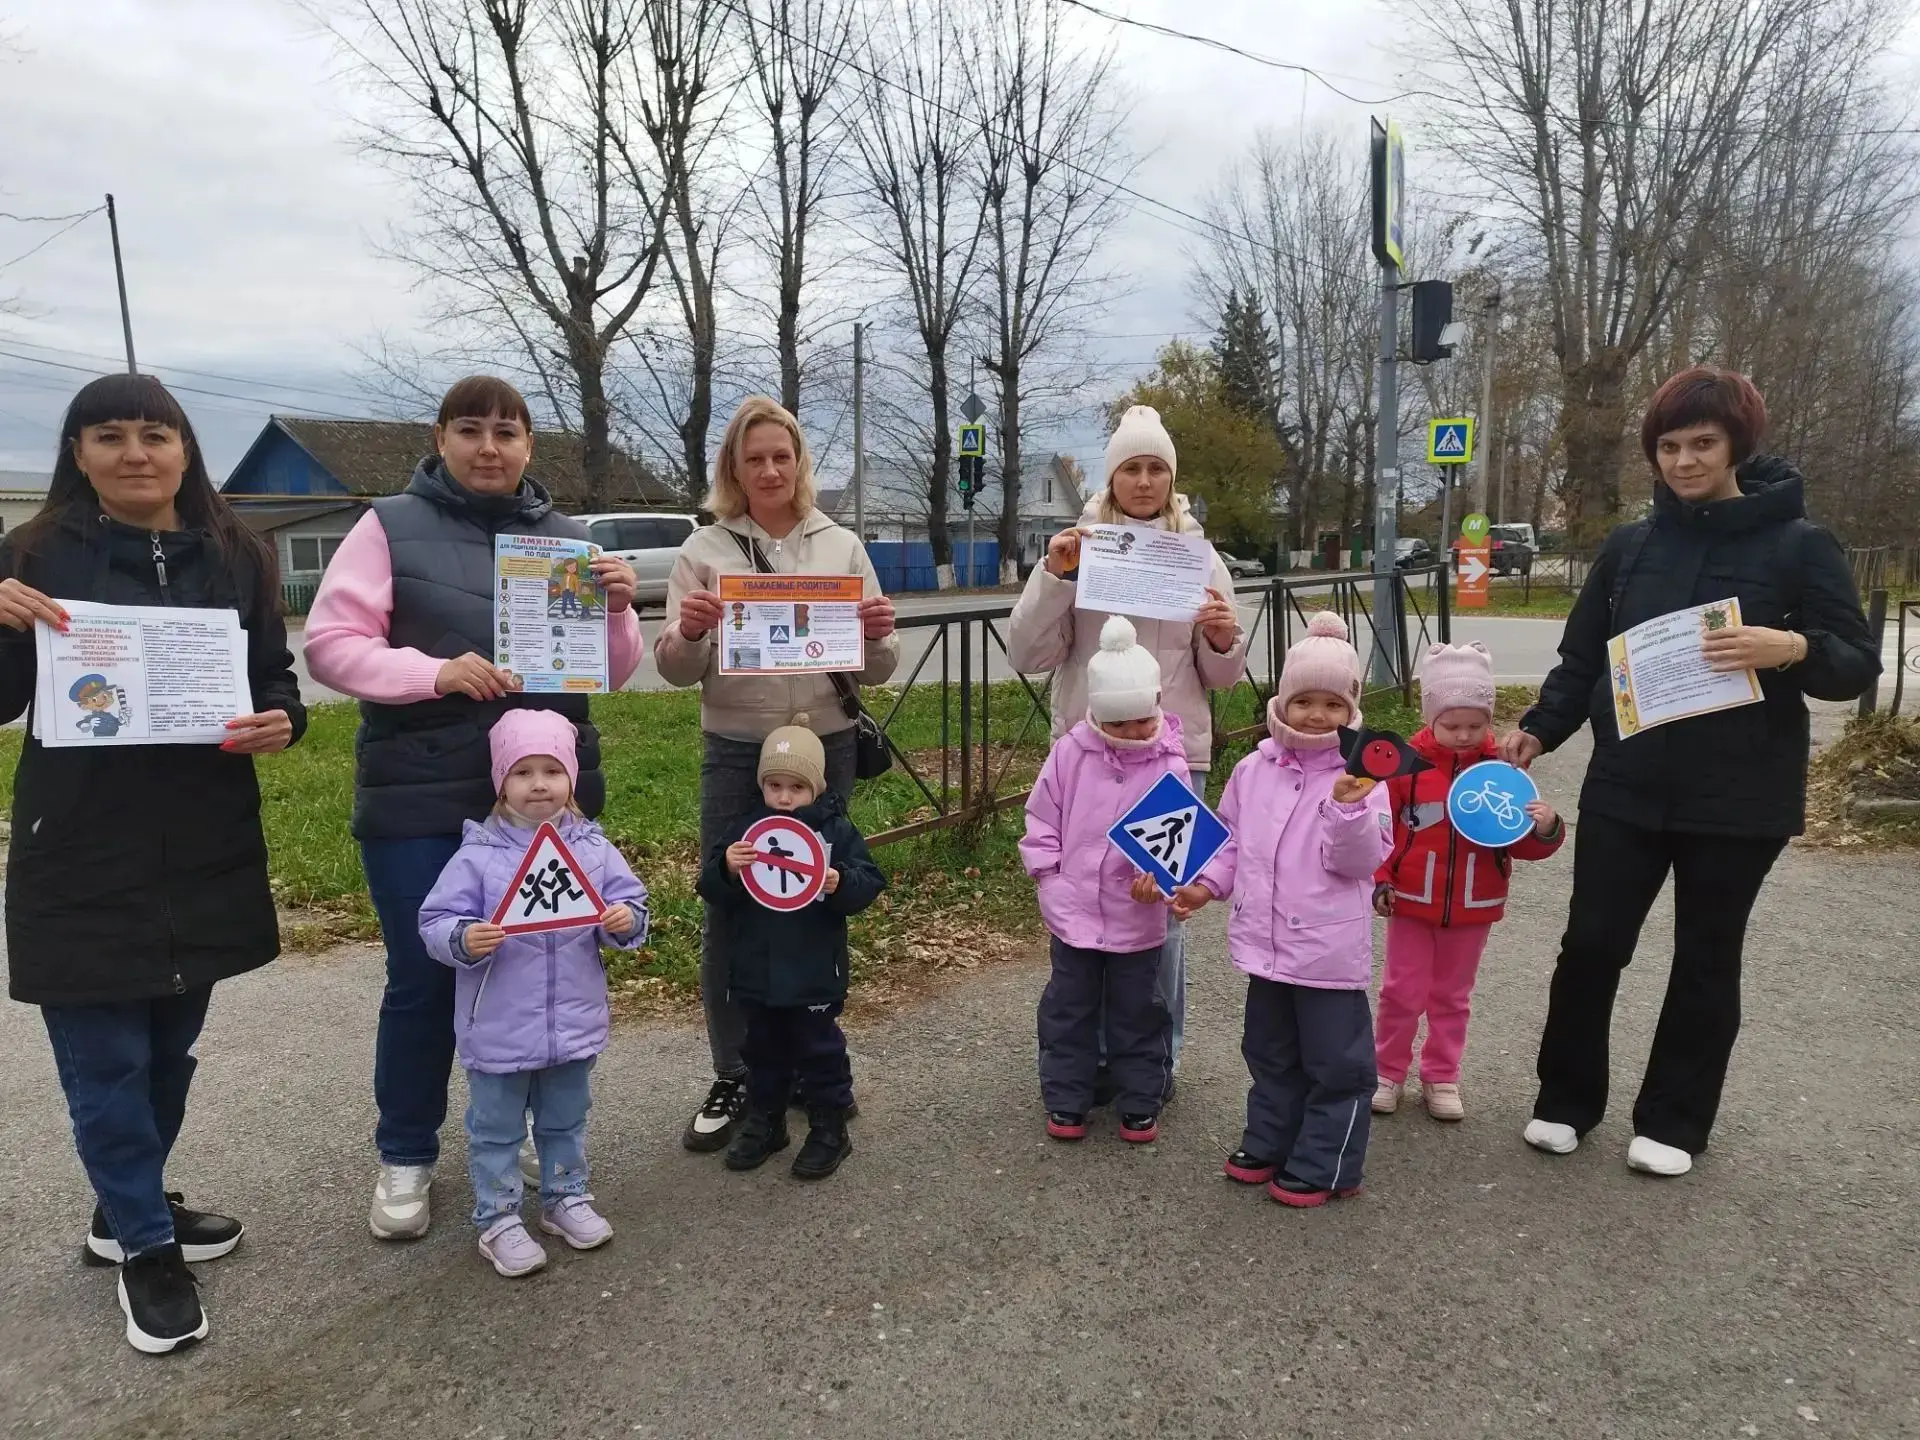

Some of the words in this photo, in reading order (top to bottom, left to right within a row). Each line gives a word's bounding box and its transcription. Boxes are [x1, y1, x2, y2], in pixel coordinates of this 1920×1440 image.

[513, 536, 562, 547] ПАМЯТКА
[536, 551, 551, 559] ПДД
[742, 581, 796, 590] УВАЖАЕМЫЕ
[797, 581, 841, 591] РОДИТЕЛИ!
[774, 660, 803, 668] Желаем
[804, 660, 833, 668] доброго
[834, 658, 854, 667] пути!
